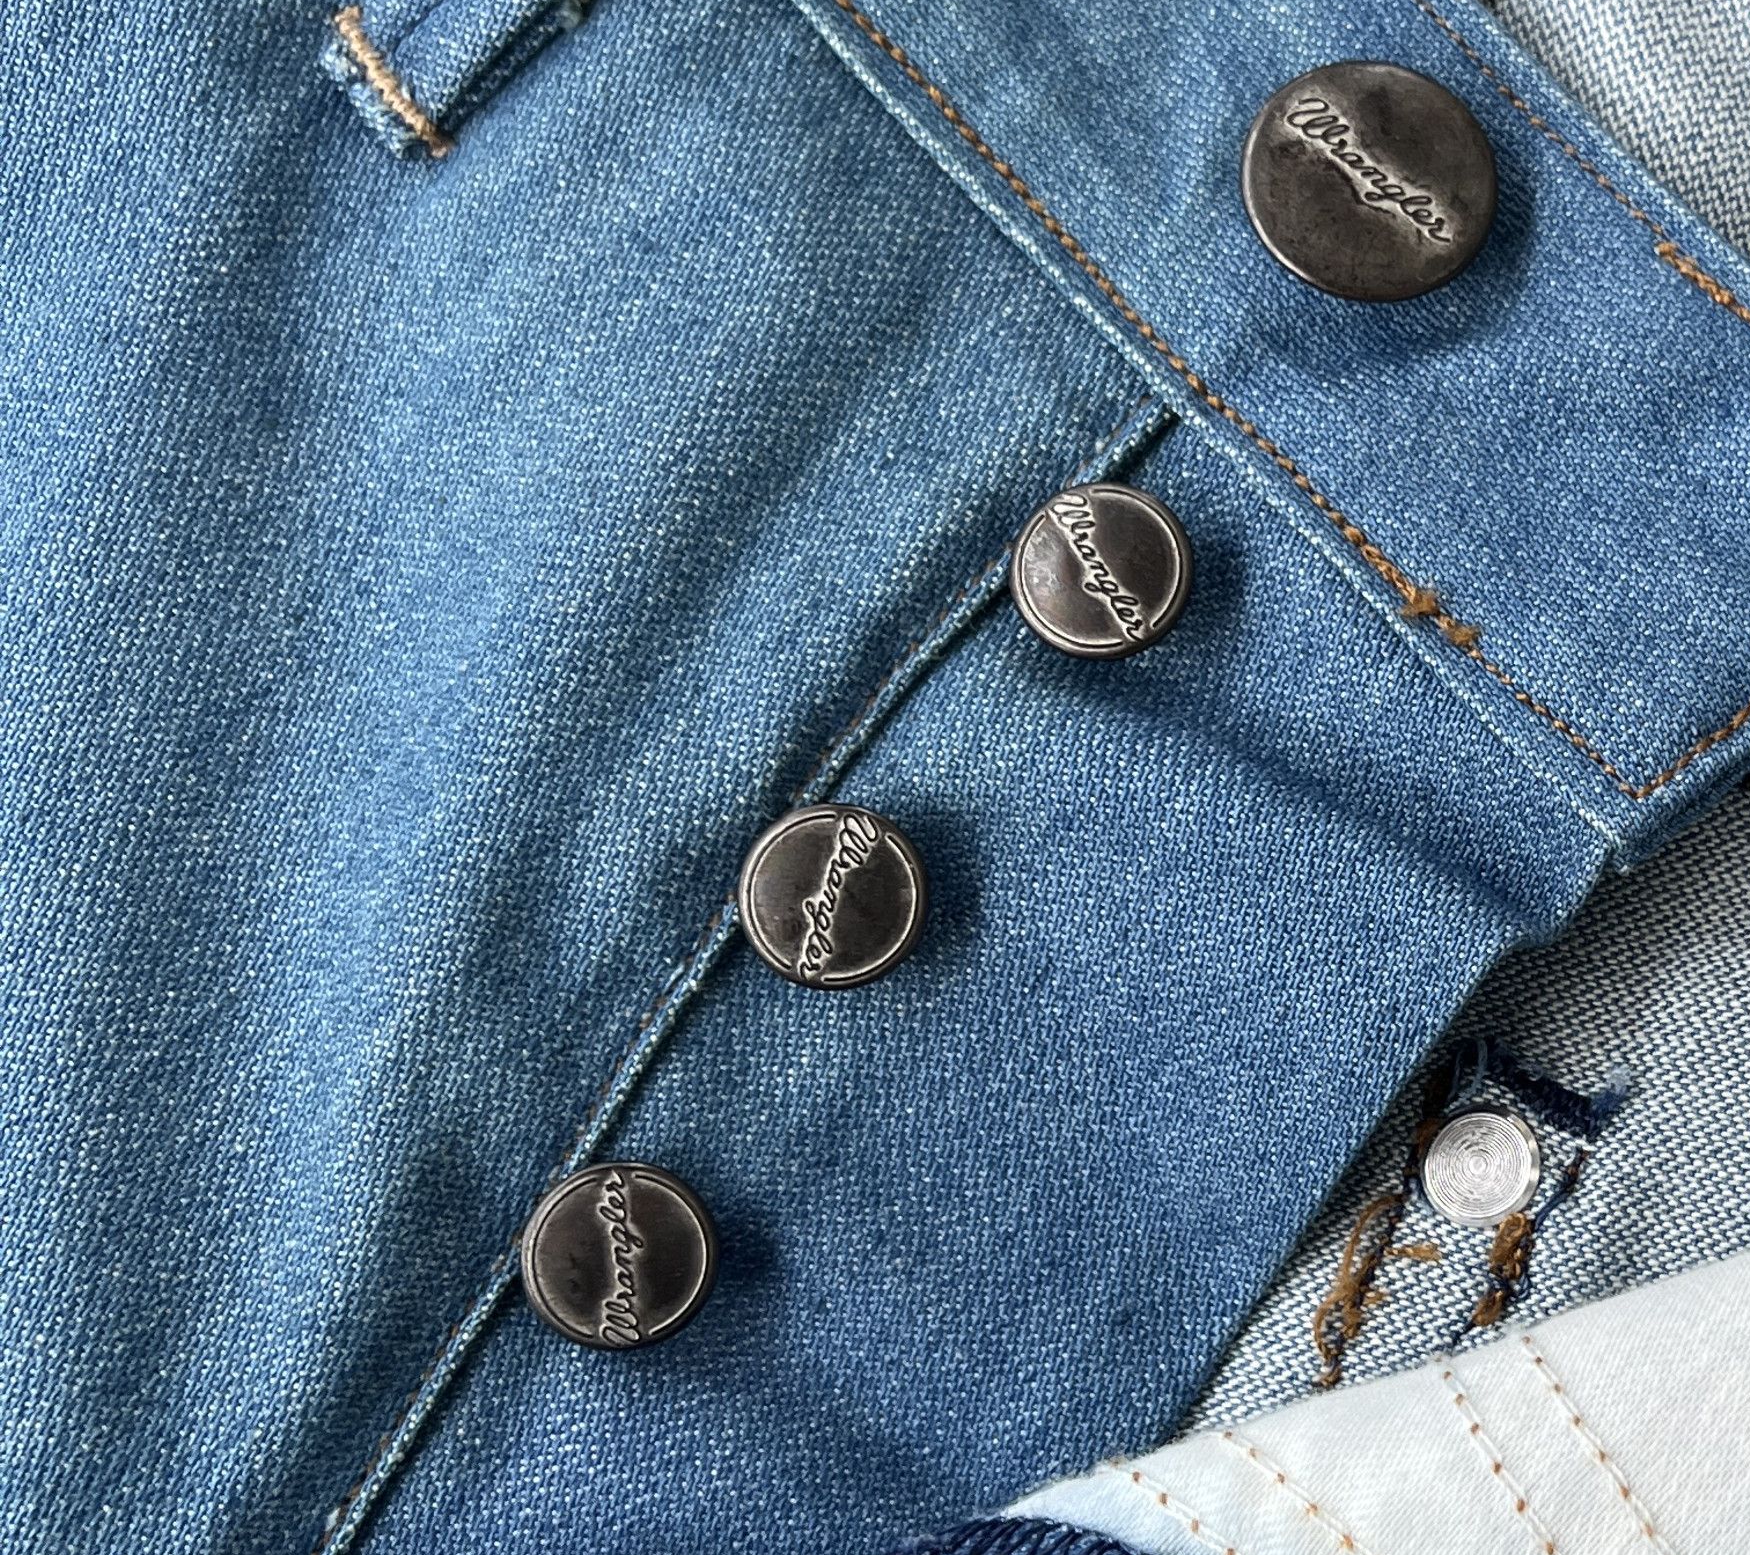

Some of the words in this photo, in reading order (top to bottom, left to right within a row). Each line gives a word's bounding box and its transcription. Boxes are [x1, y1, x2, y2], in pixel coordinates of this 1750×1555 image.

[1285, 97, 1453, 243] Wrangler
[1050, 492, 1144, 642] Wrangler
[799, 812, 880, 980] Wrangler
[600, 1169, 644, 1343] Wrangler
